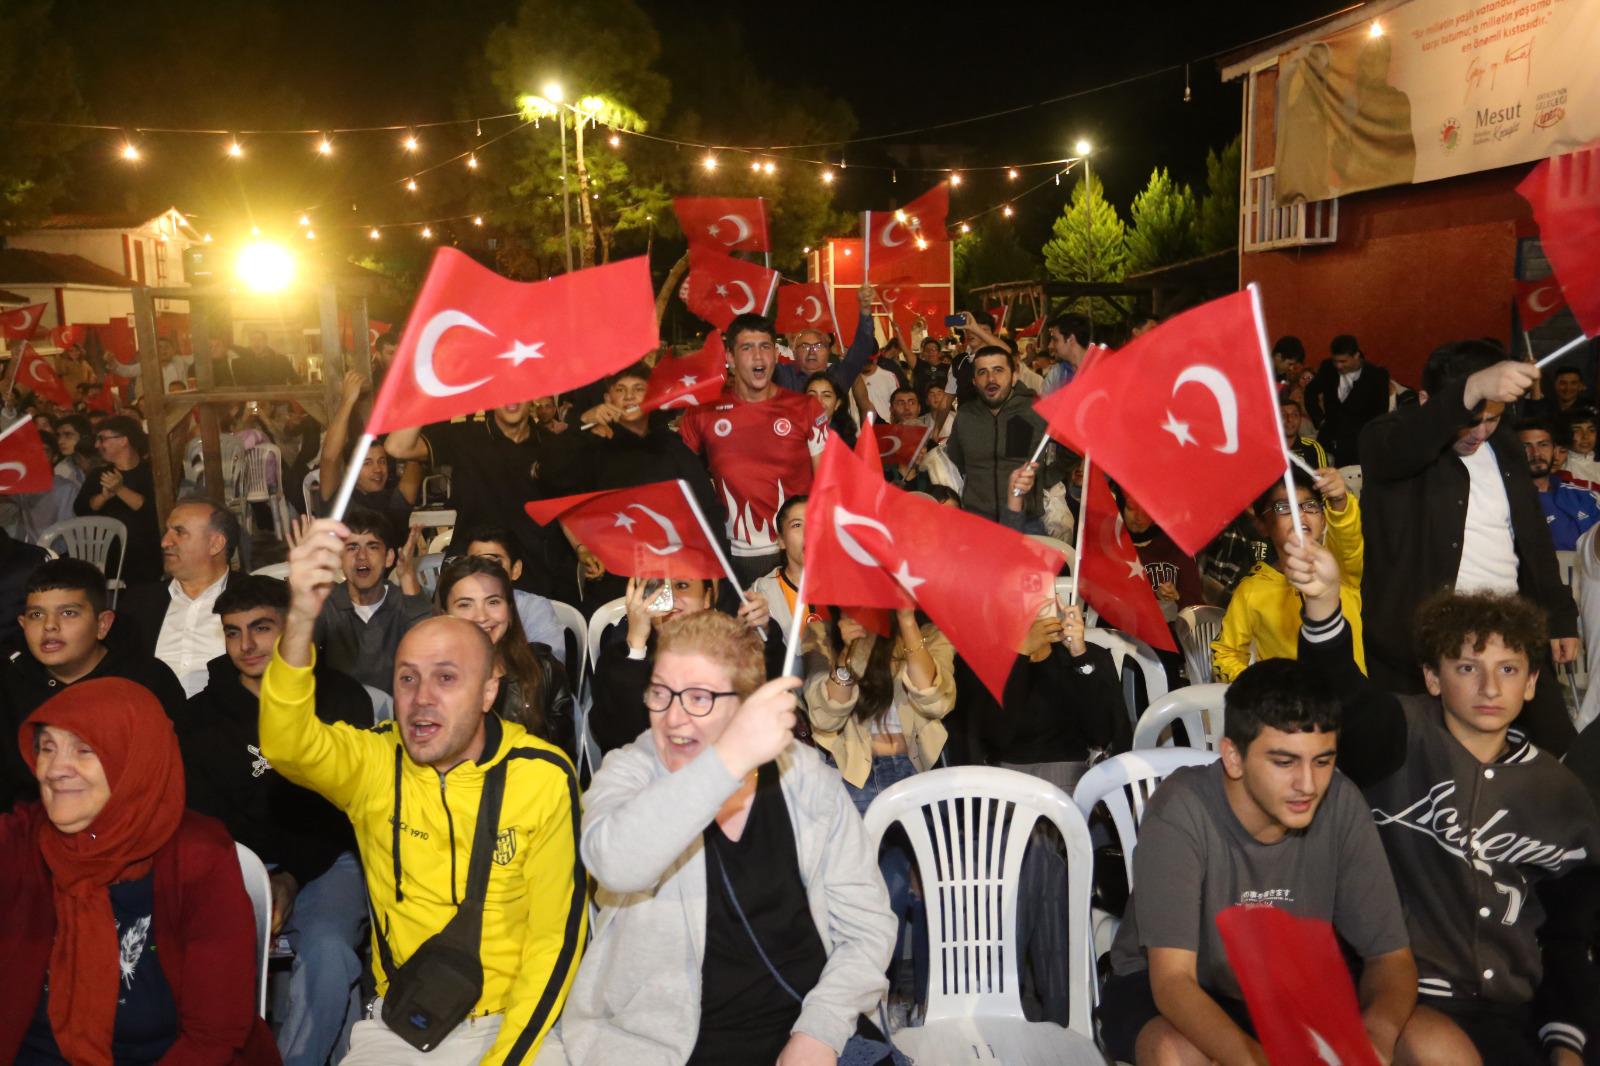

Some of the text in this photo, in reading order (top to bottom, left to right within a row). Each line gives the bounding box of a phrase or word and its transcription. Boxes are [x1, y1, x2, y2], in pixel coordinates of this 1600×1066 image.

[1480, 13, 1513, 30] milletin
[1473, 29, 1502, 49] önemli
[1474, 102, 1522, 129] Mesut
[410, 828, 429, 841] 1910
[1493, 881, 1522, 926] 7
